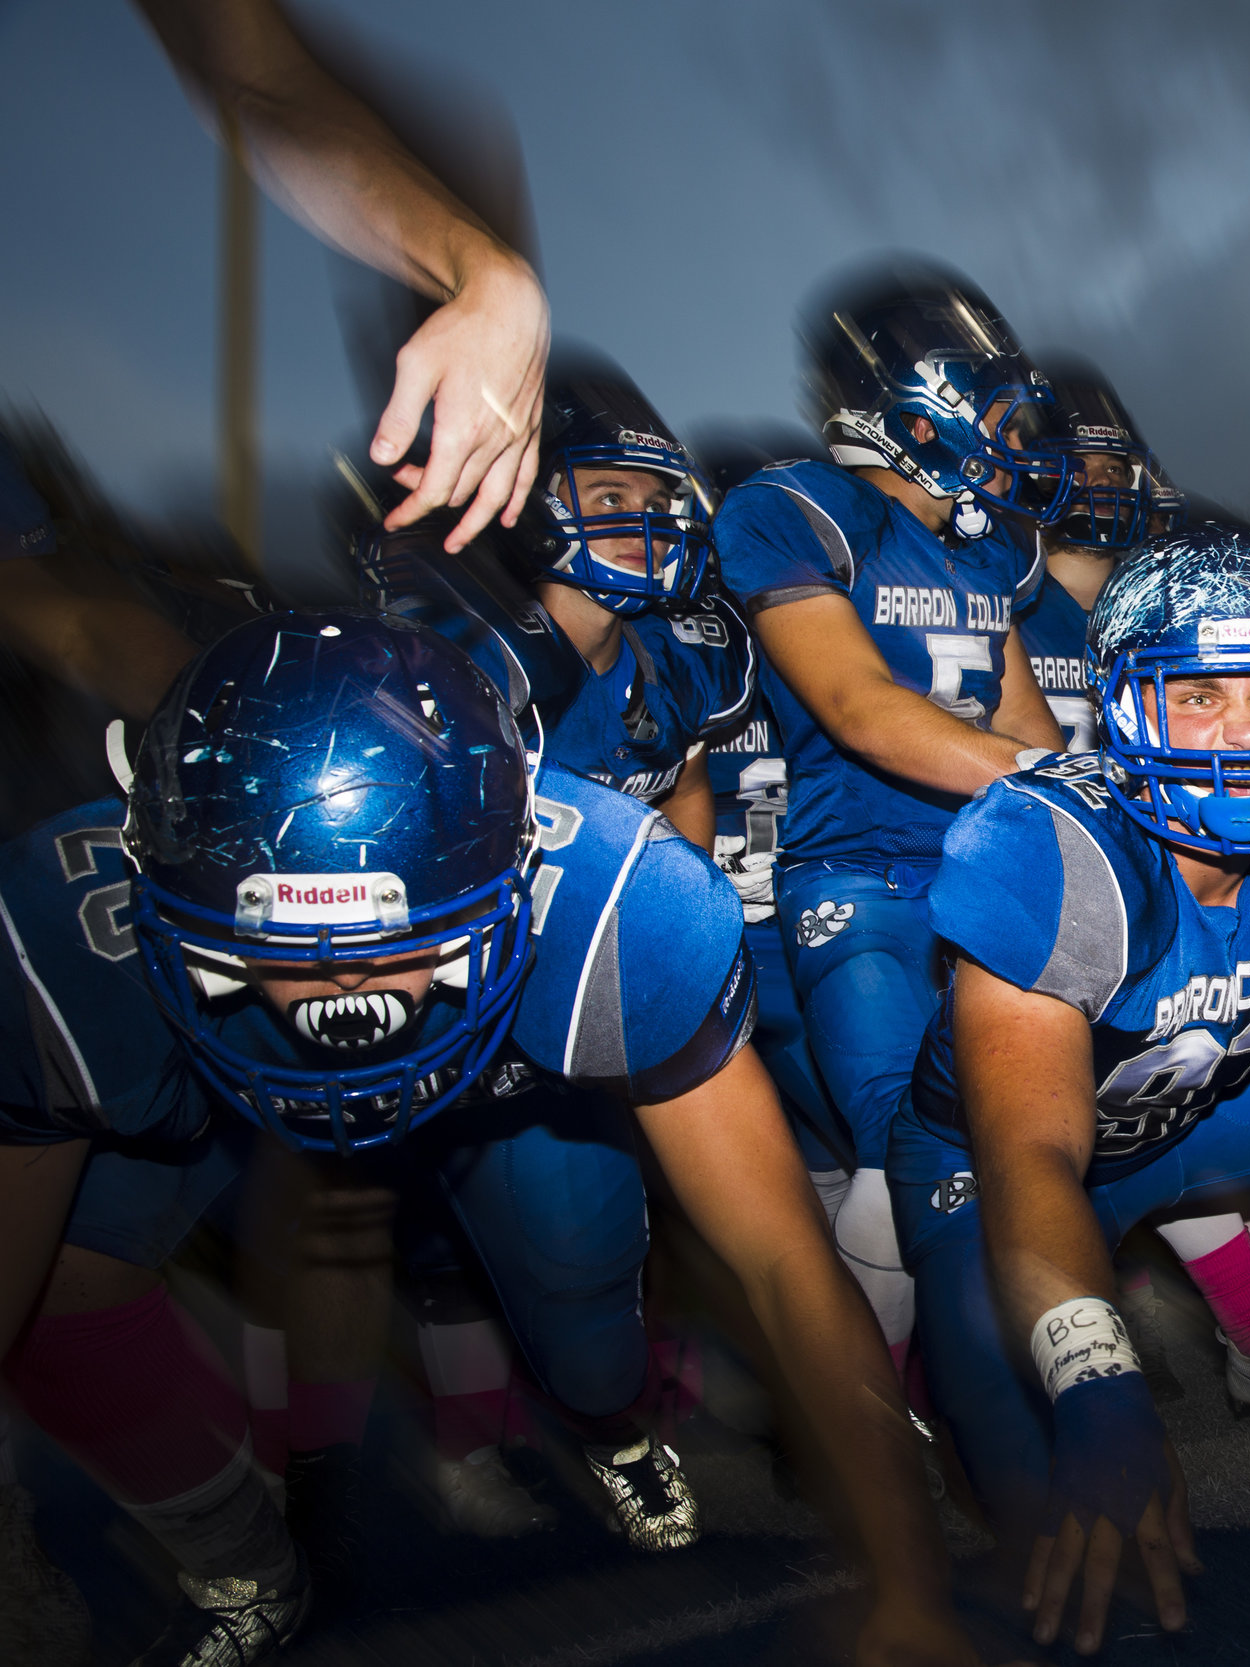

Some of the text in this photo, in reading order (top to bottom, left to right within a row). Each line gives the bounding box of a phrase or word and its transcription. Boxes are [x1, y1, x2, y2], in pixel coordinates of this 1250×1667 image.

[636, 434, 673, 451] Riddell
[854, 420, 902, 458] ARMOUR
[1088, 426, 1118, 438] Riddell
[873, 585, 957, 628] BARRON
[276, 882, 367, 905] Riddell
[1141, 971, 1238, 1044] BARON
[1046, 1308, 1097, 1347] BC
